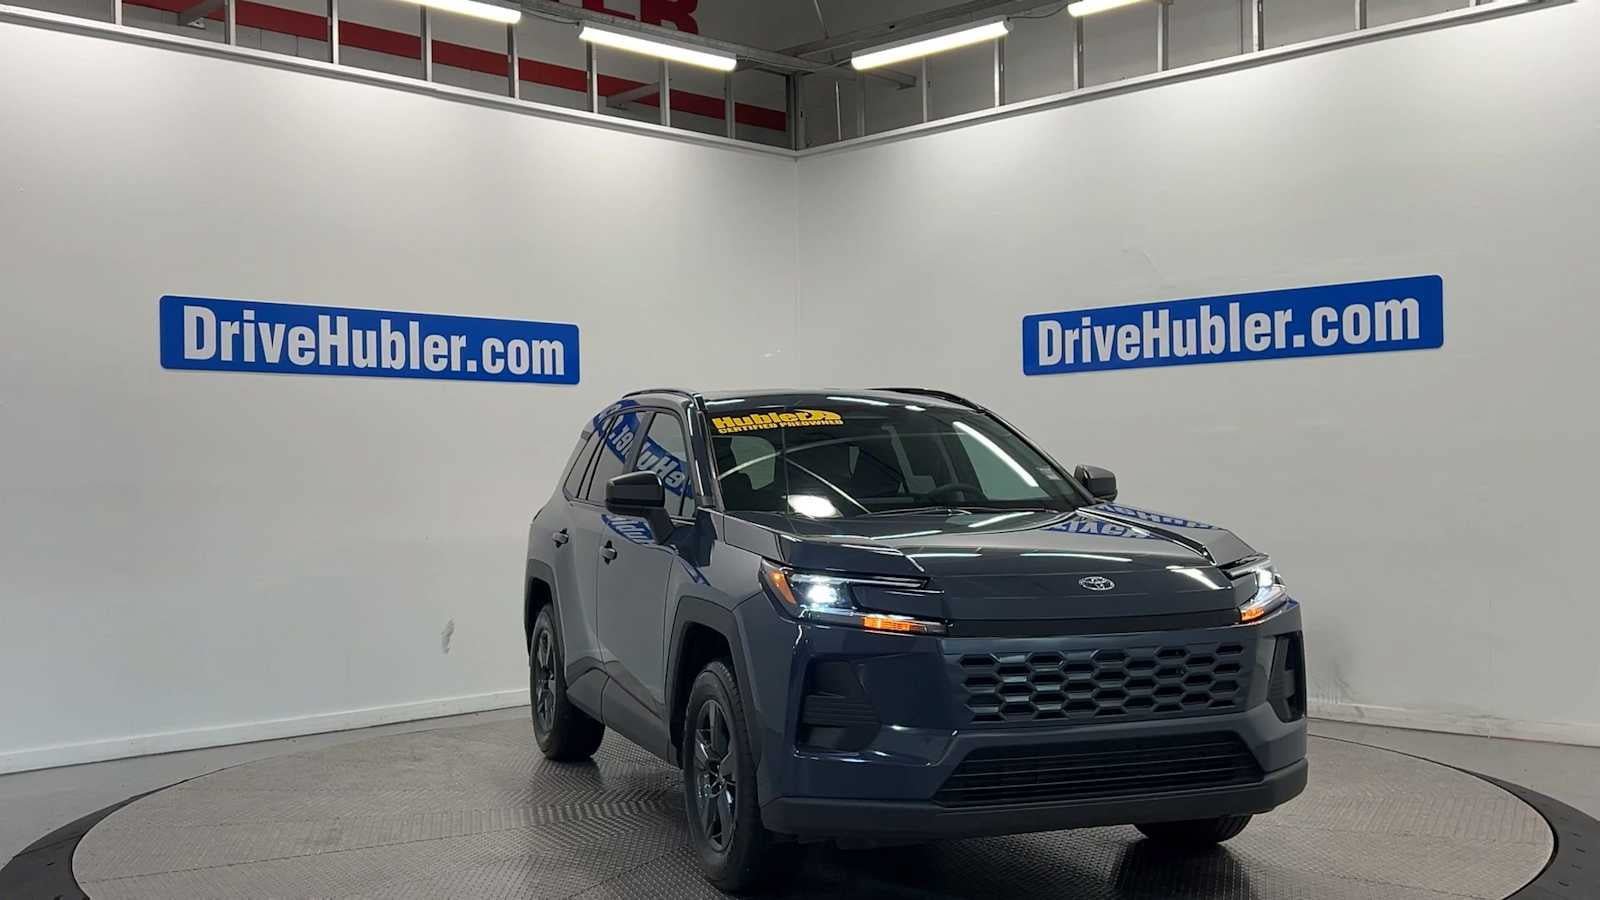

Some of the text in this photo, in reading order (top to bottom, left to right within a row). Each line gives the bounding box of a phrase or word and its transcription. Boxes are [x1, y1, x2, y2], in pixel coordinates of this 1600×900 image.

[183, 305, 566, 375] DriveHubler.com
[1038, 297, 1420, 366] DriveHubler.com
[712, 410, 812, 429] Hubler
[718, 423, 779, 434] CERTIFIED
